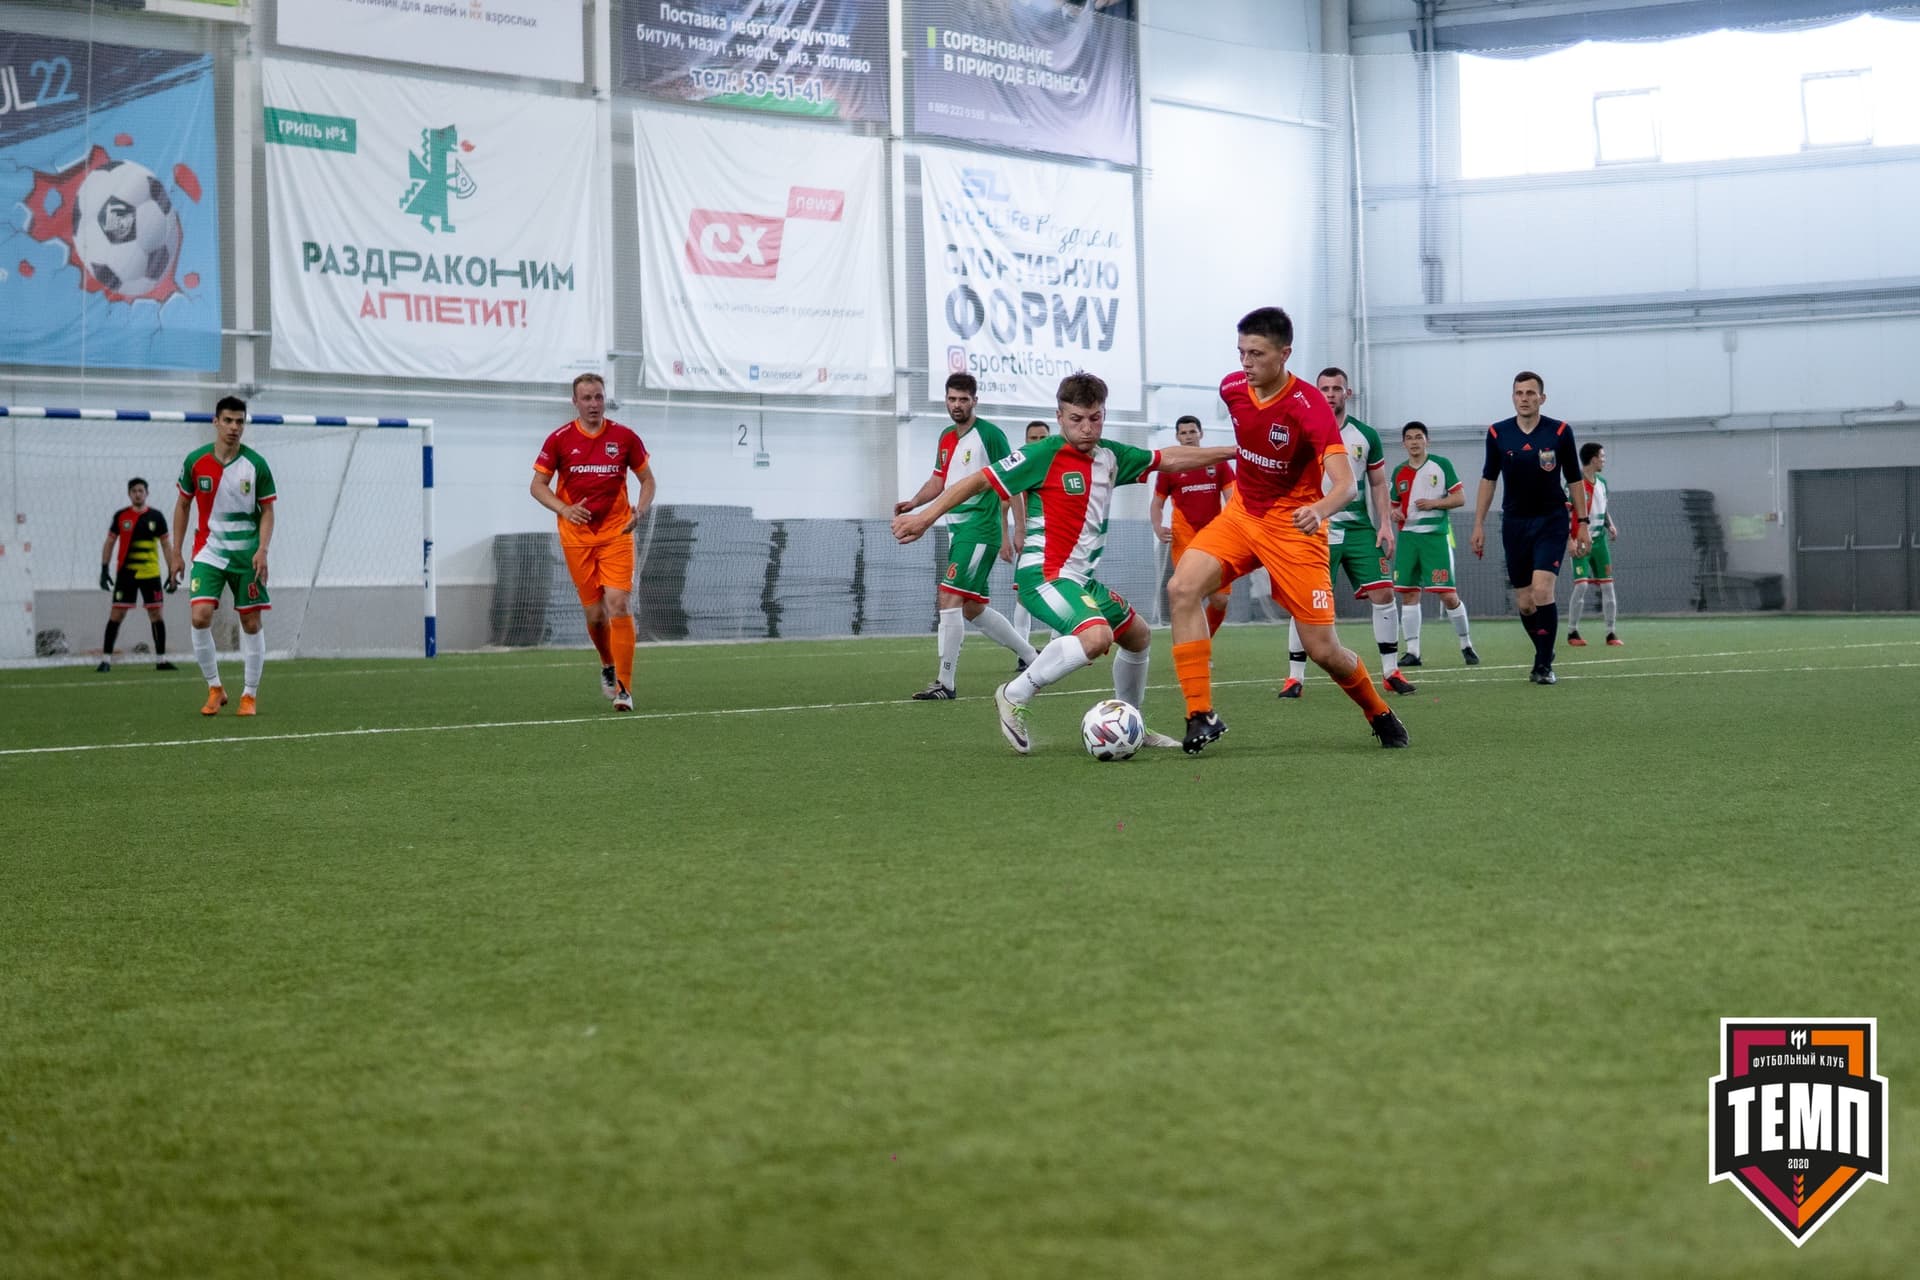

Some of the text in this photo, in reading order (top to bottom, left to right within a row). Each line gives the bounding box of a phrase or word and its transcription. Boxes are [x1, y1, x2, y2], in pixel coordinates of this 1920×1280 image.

[423, 4, 457, 18] детей
[459, 8, 467, 17] и
[485, 12, 538, 28] взрослых
[660, 3, 851, 48] Поставка нефтепродуктов:
[636, 24, 685, 49] битум,
[688, 34, 735, 58] мазут,
[736, 43, 784, 66] нефть,
[816, 52, 871, 74] топливо
[943, 30, 1054, 66] СОРЕВНОВАНИЕ
[743, 70, 824, 105] 39-51-41
[943, 54, 1089, 96] В ПРИРОДЕ БИЗНЕСА
[278, 119, 348, 142] ГРИЛЬ №1
[796, 196, 836, 212] news
[302, 241, 575, 291] РАЗДРАКОНИМ
[946, 243, 1119, 290] СПОРТИВНУЮ
[360, 290, 528, 328] АППЕТИТ!
[945, 284, 1120, 352] ФОРМУ
[738, 424, 748, 446] 2
[1068, 478, 1081, 489] 1E
[945, 562, 957, 580] 6
[1312, 589, 1329, 609] 22
